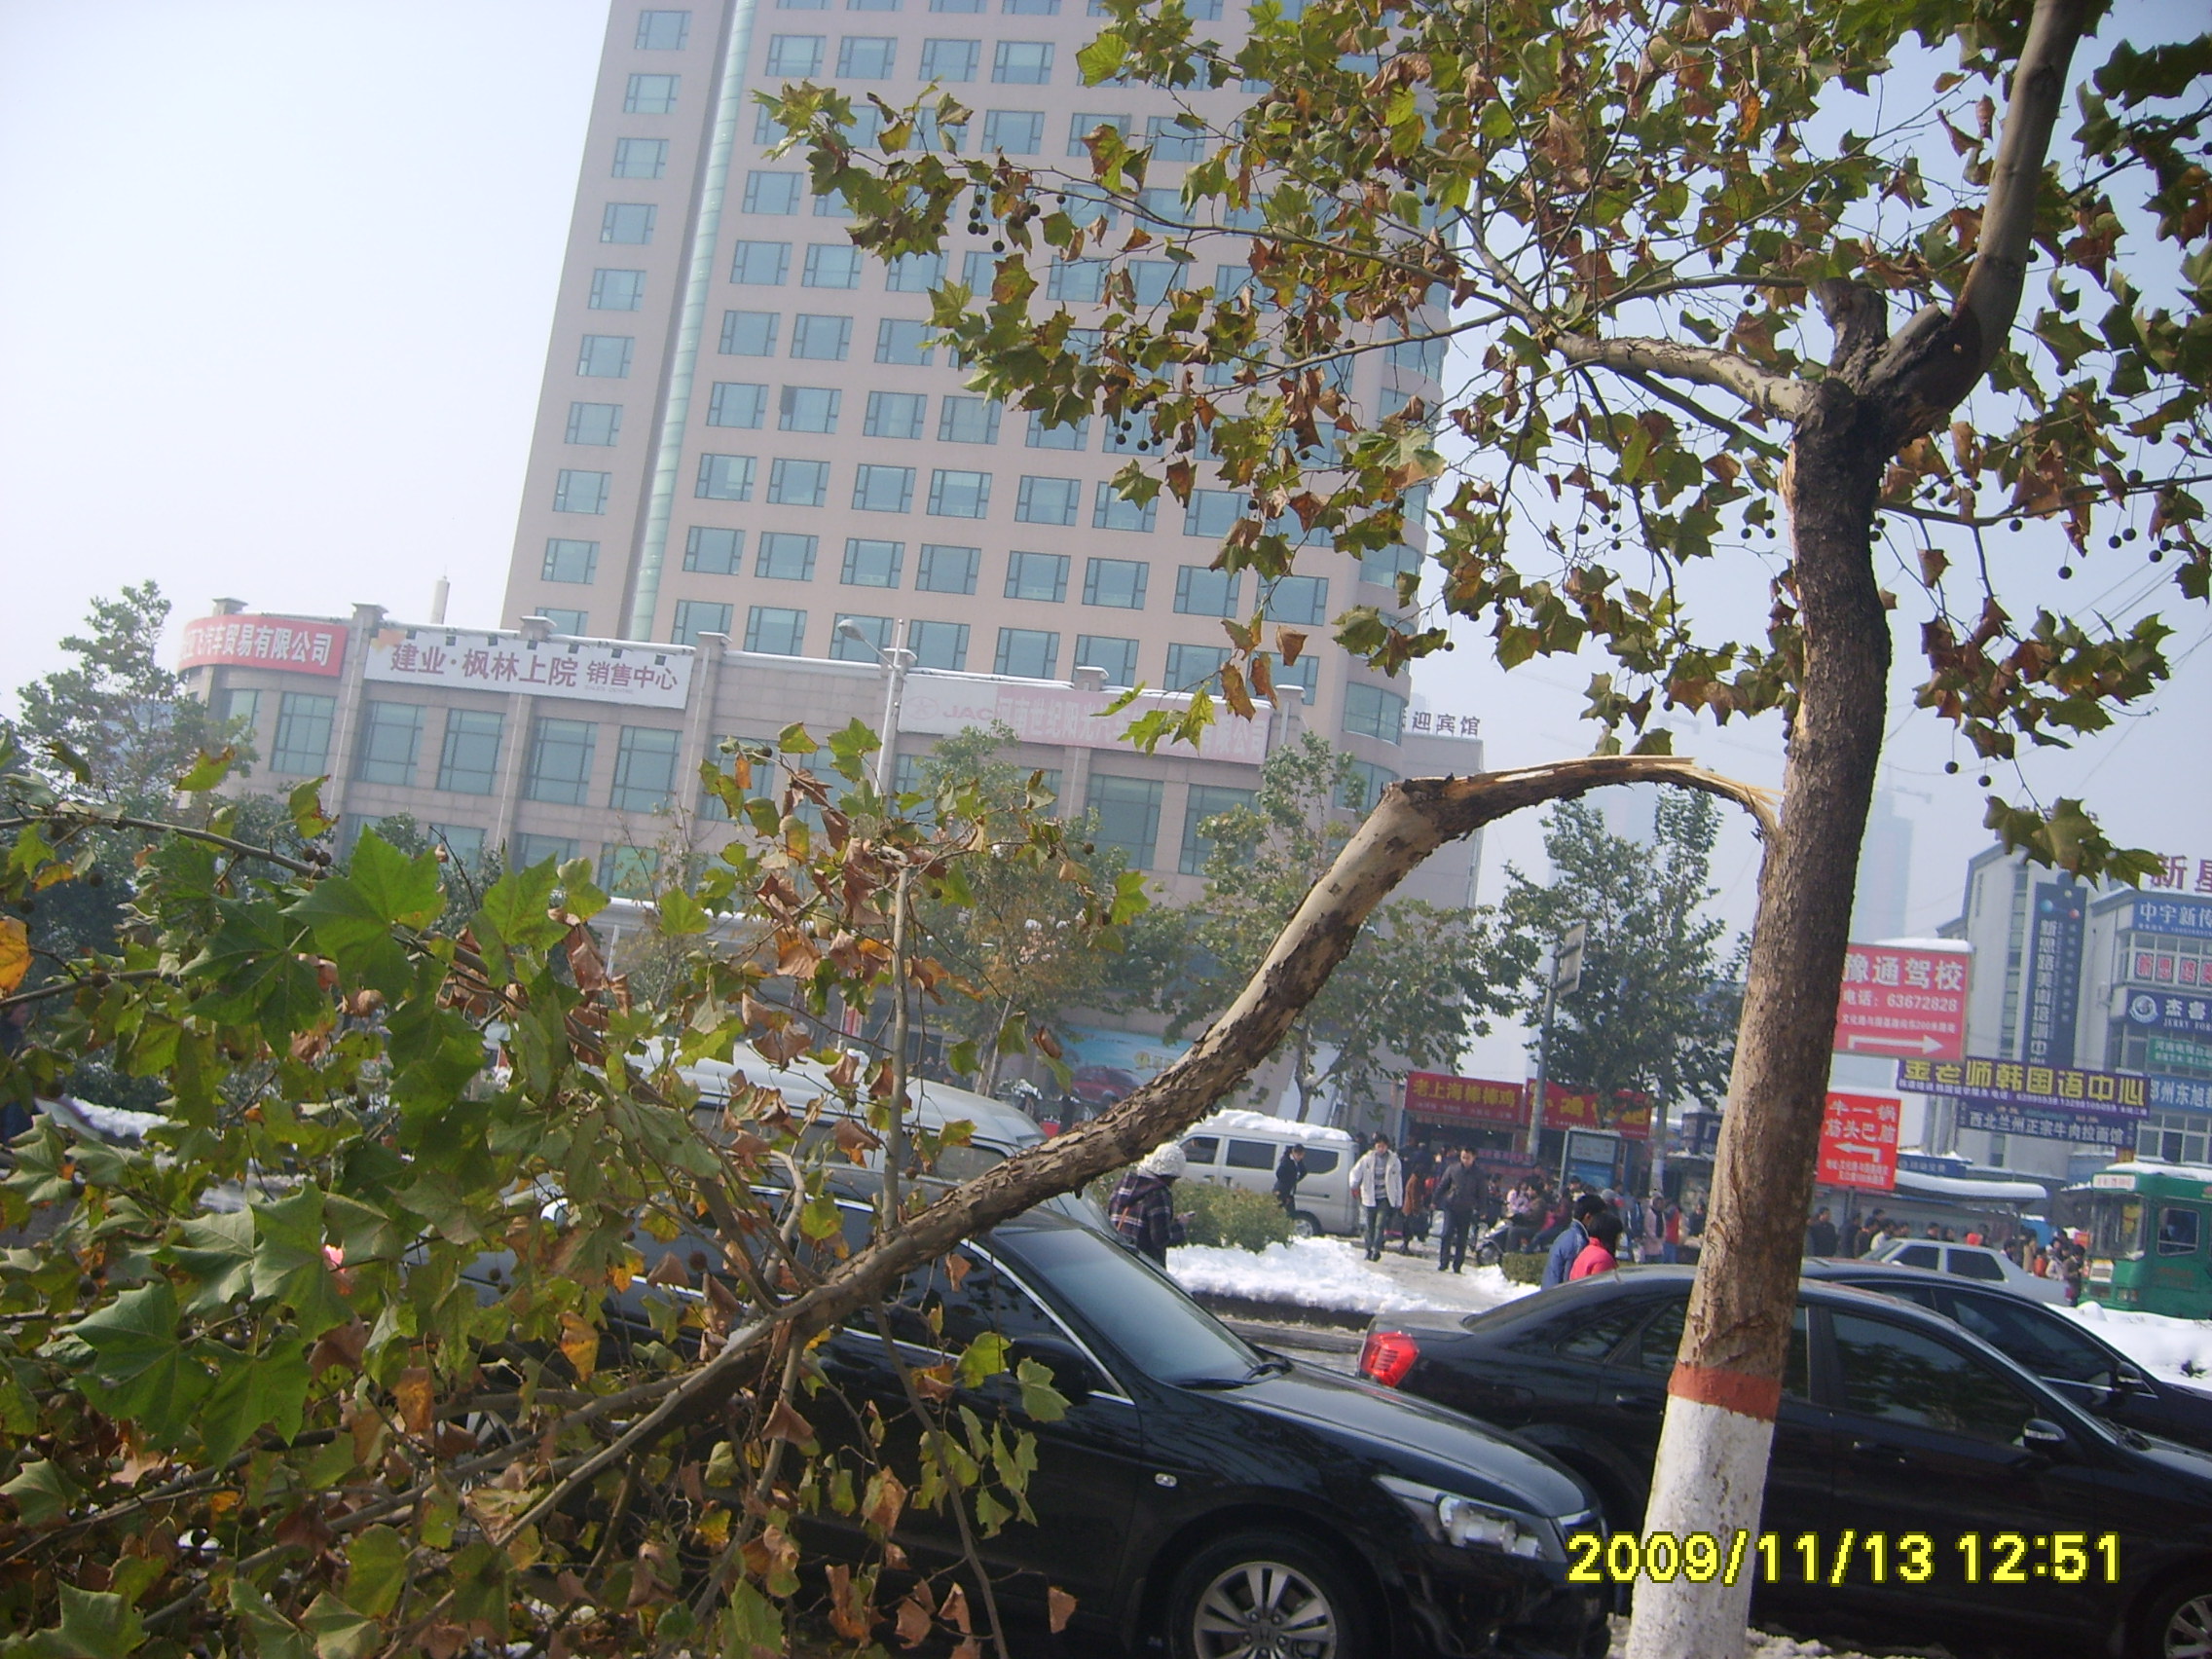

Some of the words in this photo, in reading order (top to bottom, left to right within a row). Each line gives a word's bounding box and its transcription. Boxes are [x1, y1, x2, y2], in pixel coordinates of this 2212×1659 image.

[586, 660, 678, 690] 销售中心
[942, 706, 994, 720] JAC
[1402, 709, 1481, 736] 迎宾馆
[1842, 953, 1964, 992] 豫通驾校
[1887, 993, 1958, 1013] 63672828
[1904, 1058, 2145, 1106] 金老师韩国语中心
[1970, 1110, 2123, 1145] 西北兰州正宗牛肉拉面馆
